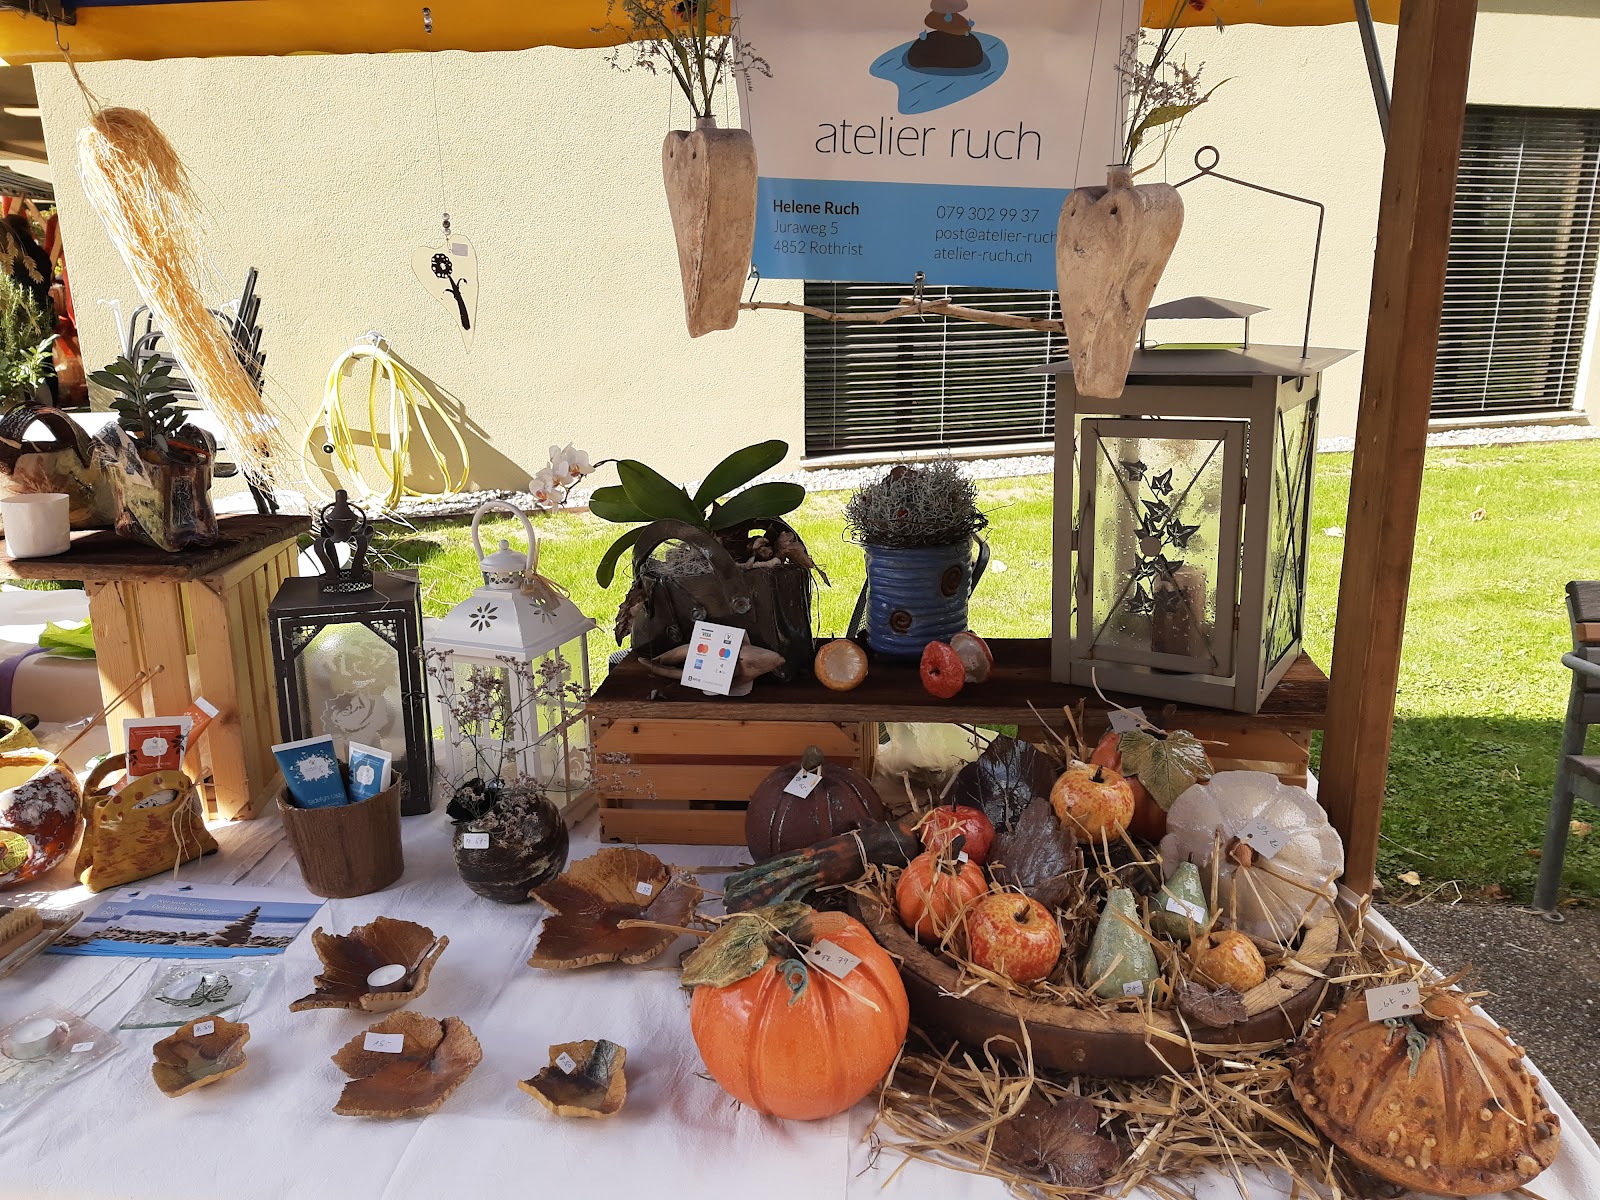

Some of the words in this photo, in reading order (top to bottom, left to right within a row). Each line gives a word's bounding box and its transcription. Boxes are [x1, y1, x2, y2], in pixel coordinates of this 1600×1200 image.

[815, 116, 936, 158] atelier
[950, 121, 1042, 161] ruch
[773, 199, 822, 214] Helene
[824, 201, 860, 216] Ruch
[936, 205, 964, 221] 079
[965, 206, 995, 222] 302
[998, 208, 1018, 222] 99
[1020, 208, 1040, 223] 37
[774, 221, 828, 237] Juraweg
[829, 222, 839, 235] 5
[774, 240, 807, 255] 4852
[809, 241, 863, 256] Rothrist
[934, 247, 1033, 264] atelier-ruch.ch
